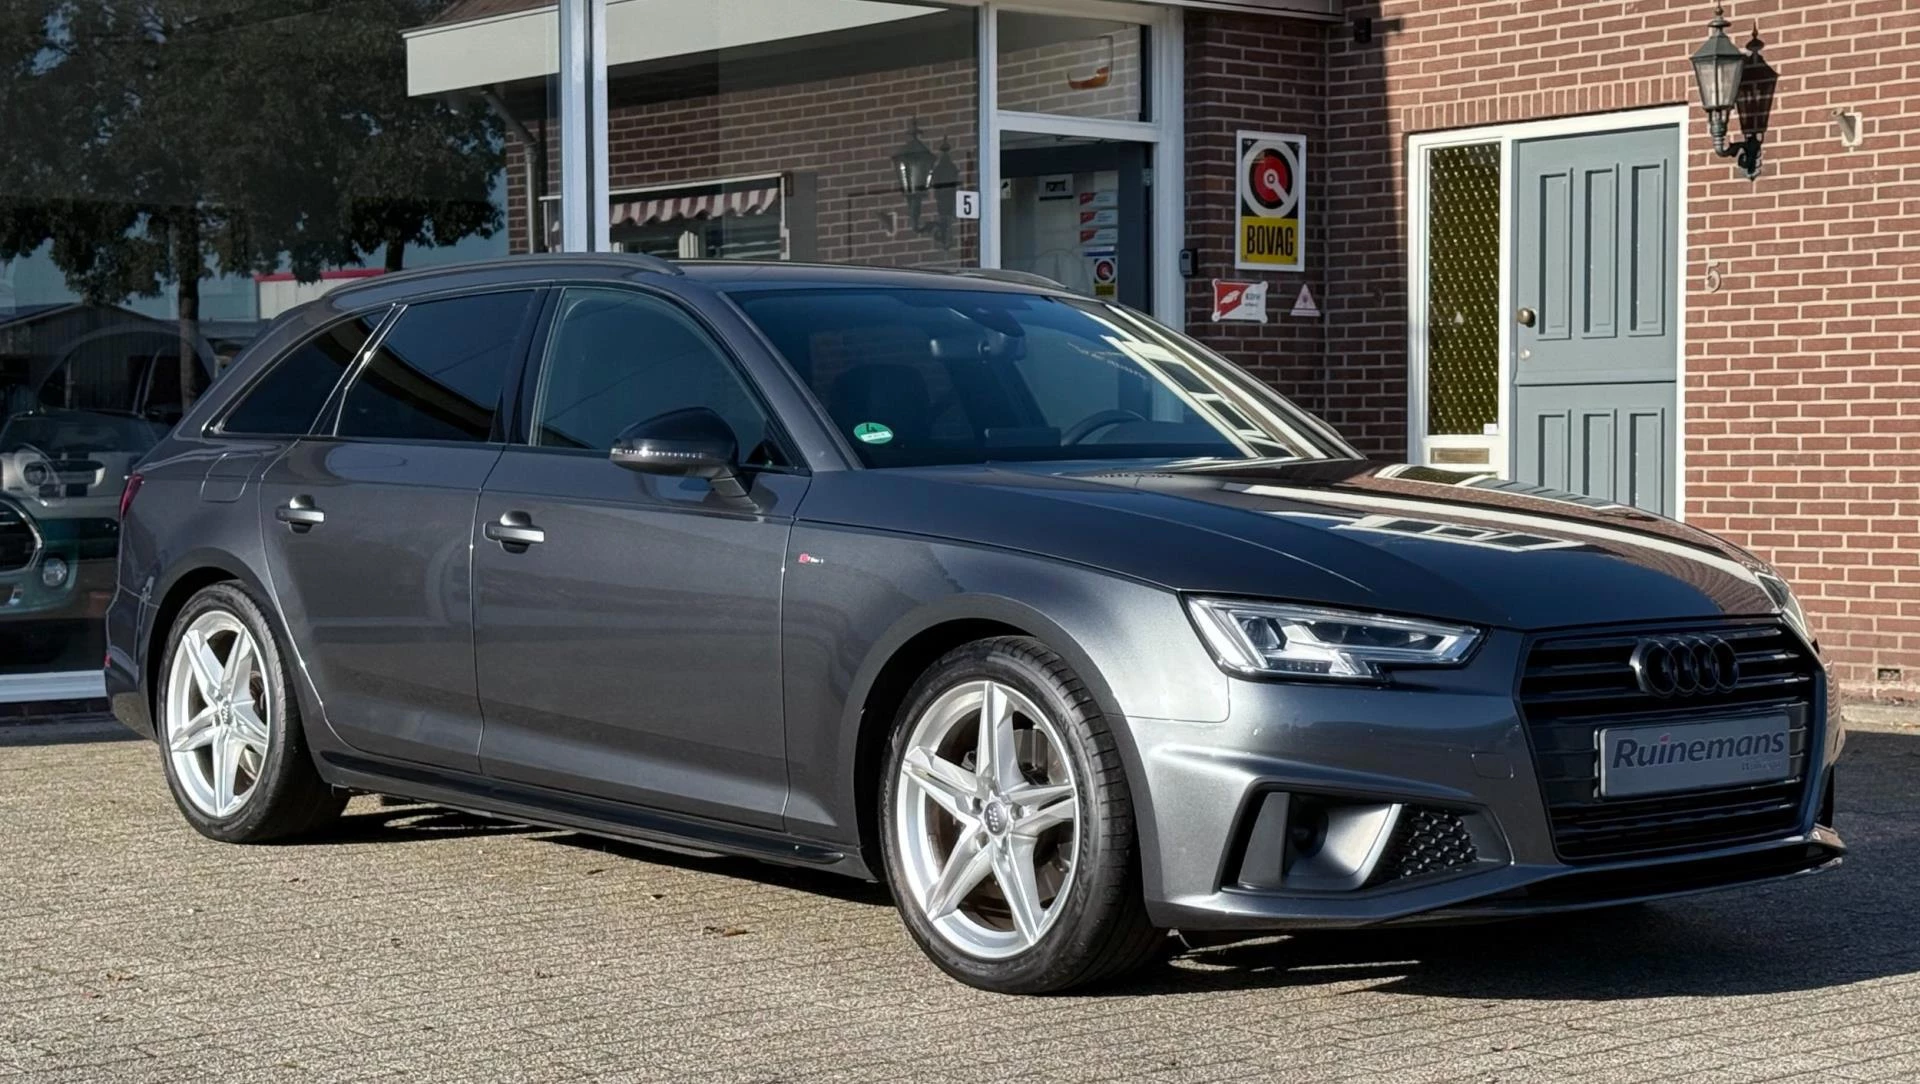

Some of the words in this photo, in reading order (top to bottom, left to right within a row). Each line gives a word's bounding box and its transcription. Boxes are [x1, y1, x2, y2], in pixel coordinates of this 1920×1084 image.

[963, 195, 972, 216] 5
[1246, 224, 1294, 257] BOVAG
[1705, 259, 1721, 293] 5
[1612, 731, 1785, 769] Ruinemans
